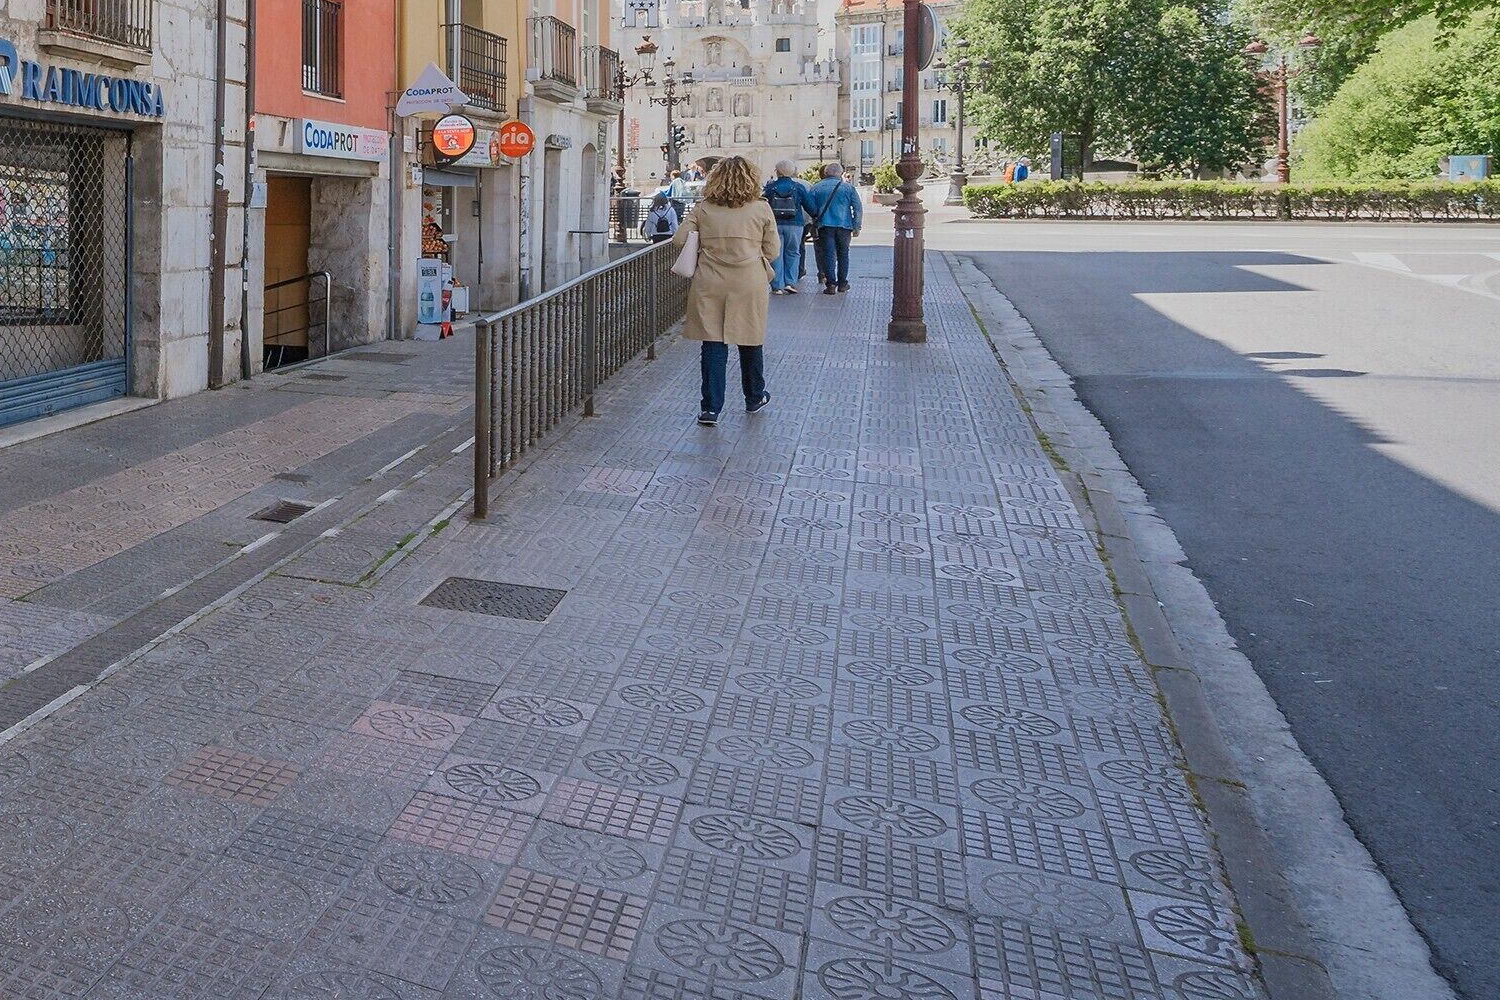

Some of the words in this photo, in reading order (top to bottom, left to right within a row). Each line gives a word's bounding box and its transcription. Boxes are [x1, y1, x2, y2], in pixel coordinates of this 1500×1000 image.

[21, 60, 165, 118] RAIMCONSA
[406, 86, 454, 97] CODAPROT
[305, 122, 358, 152] CODAPROT
[501, 126, 529, 145] ria
